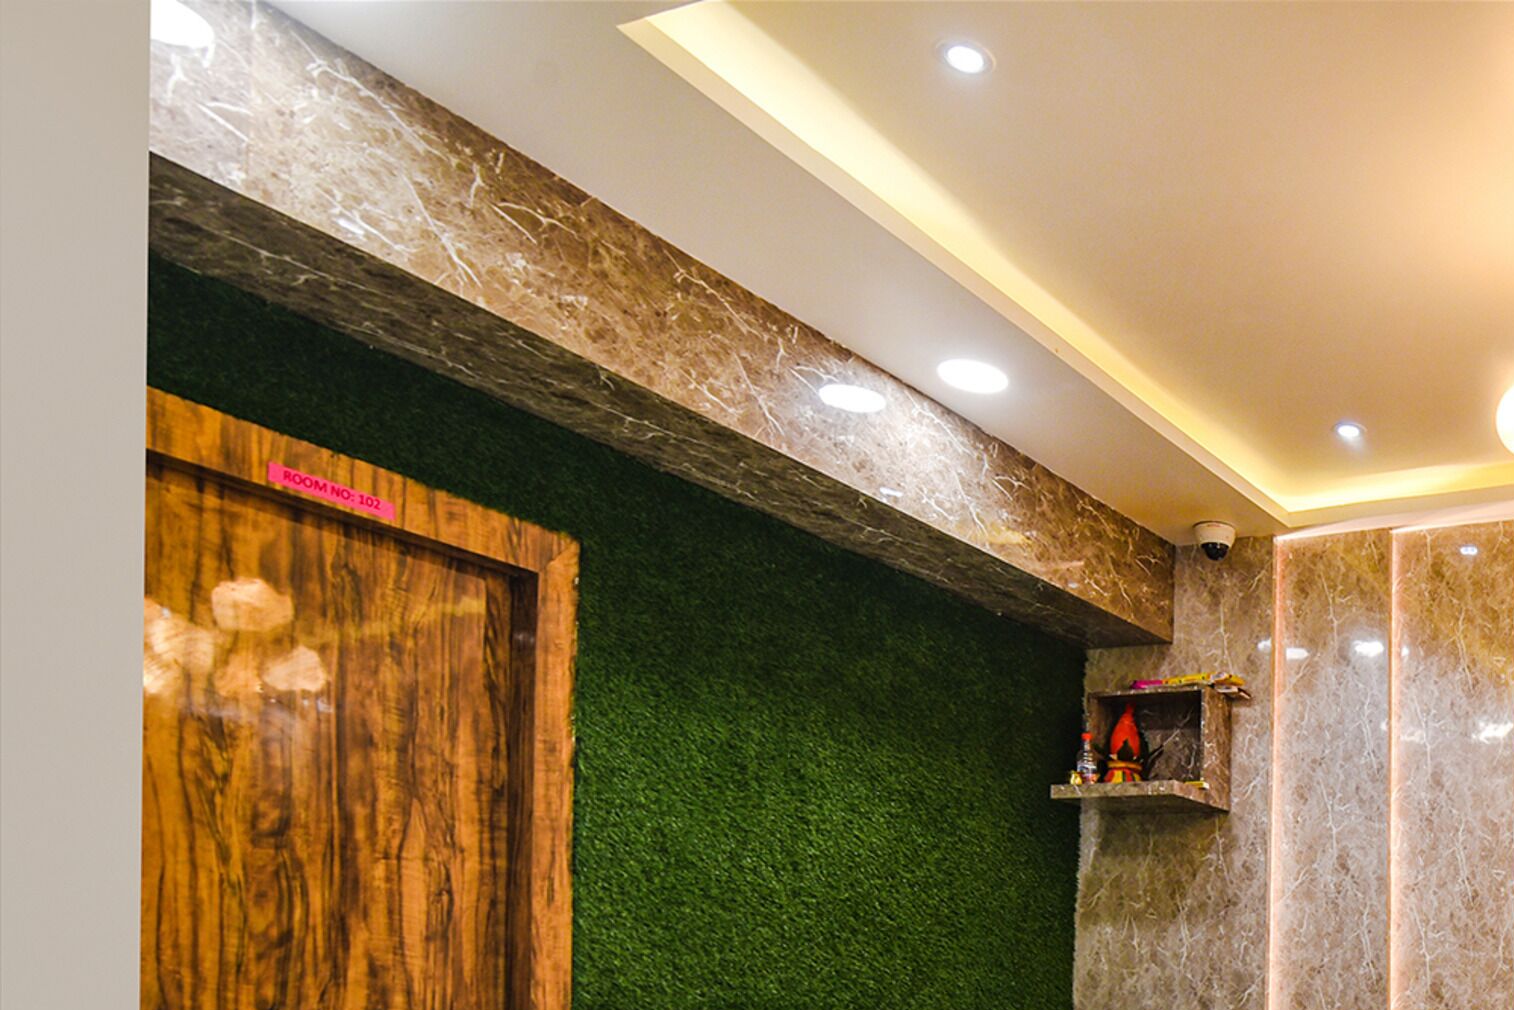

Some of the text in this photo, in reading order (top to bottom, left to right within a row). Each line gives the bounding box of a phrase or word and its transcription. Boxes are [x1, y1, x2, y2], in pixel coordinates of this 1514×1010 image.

[282, 470, 381, 511] ROOM NO: 102
